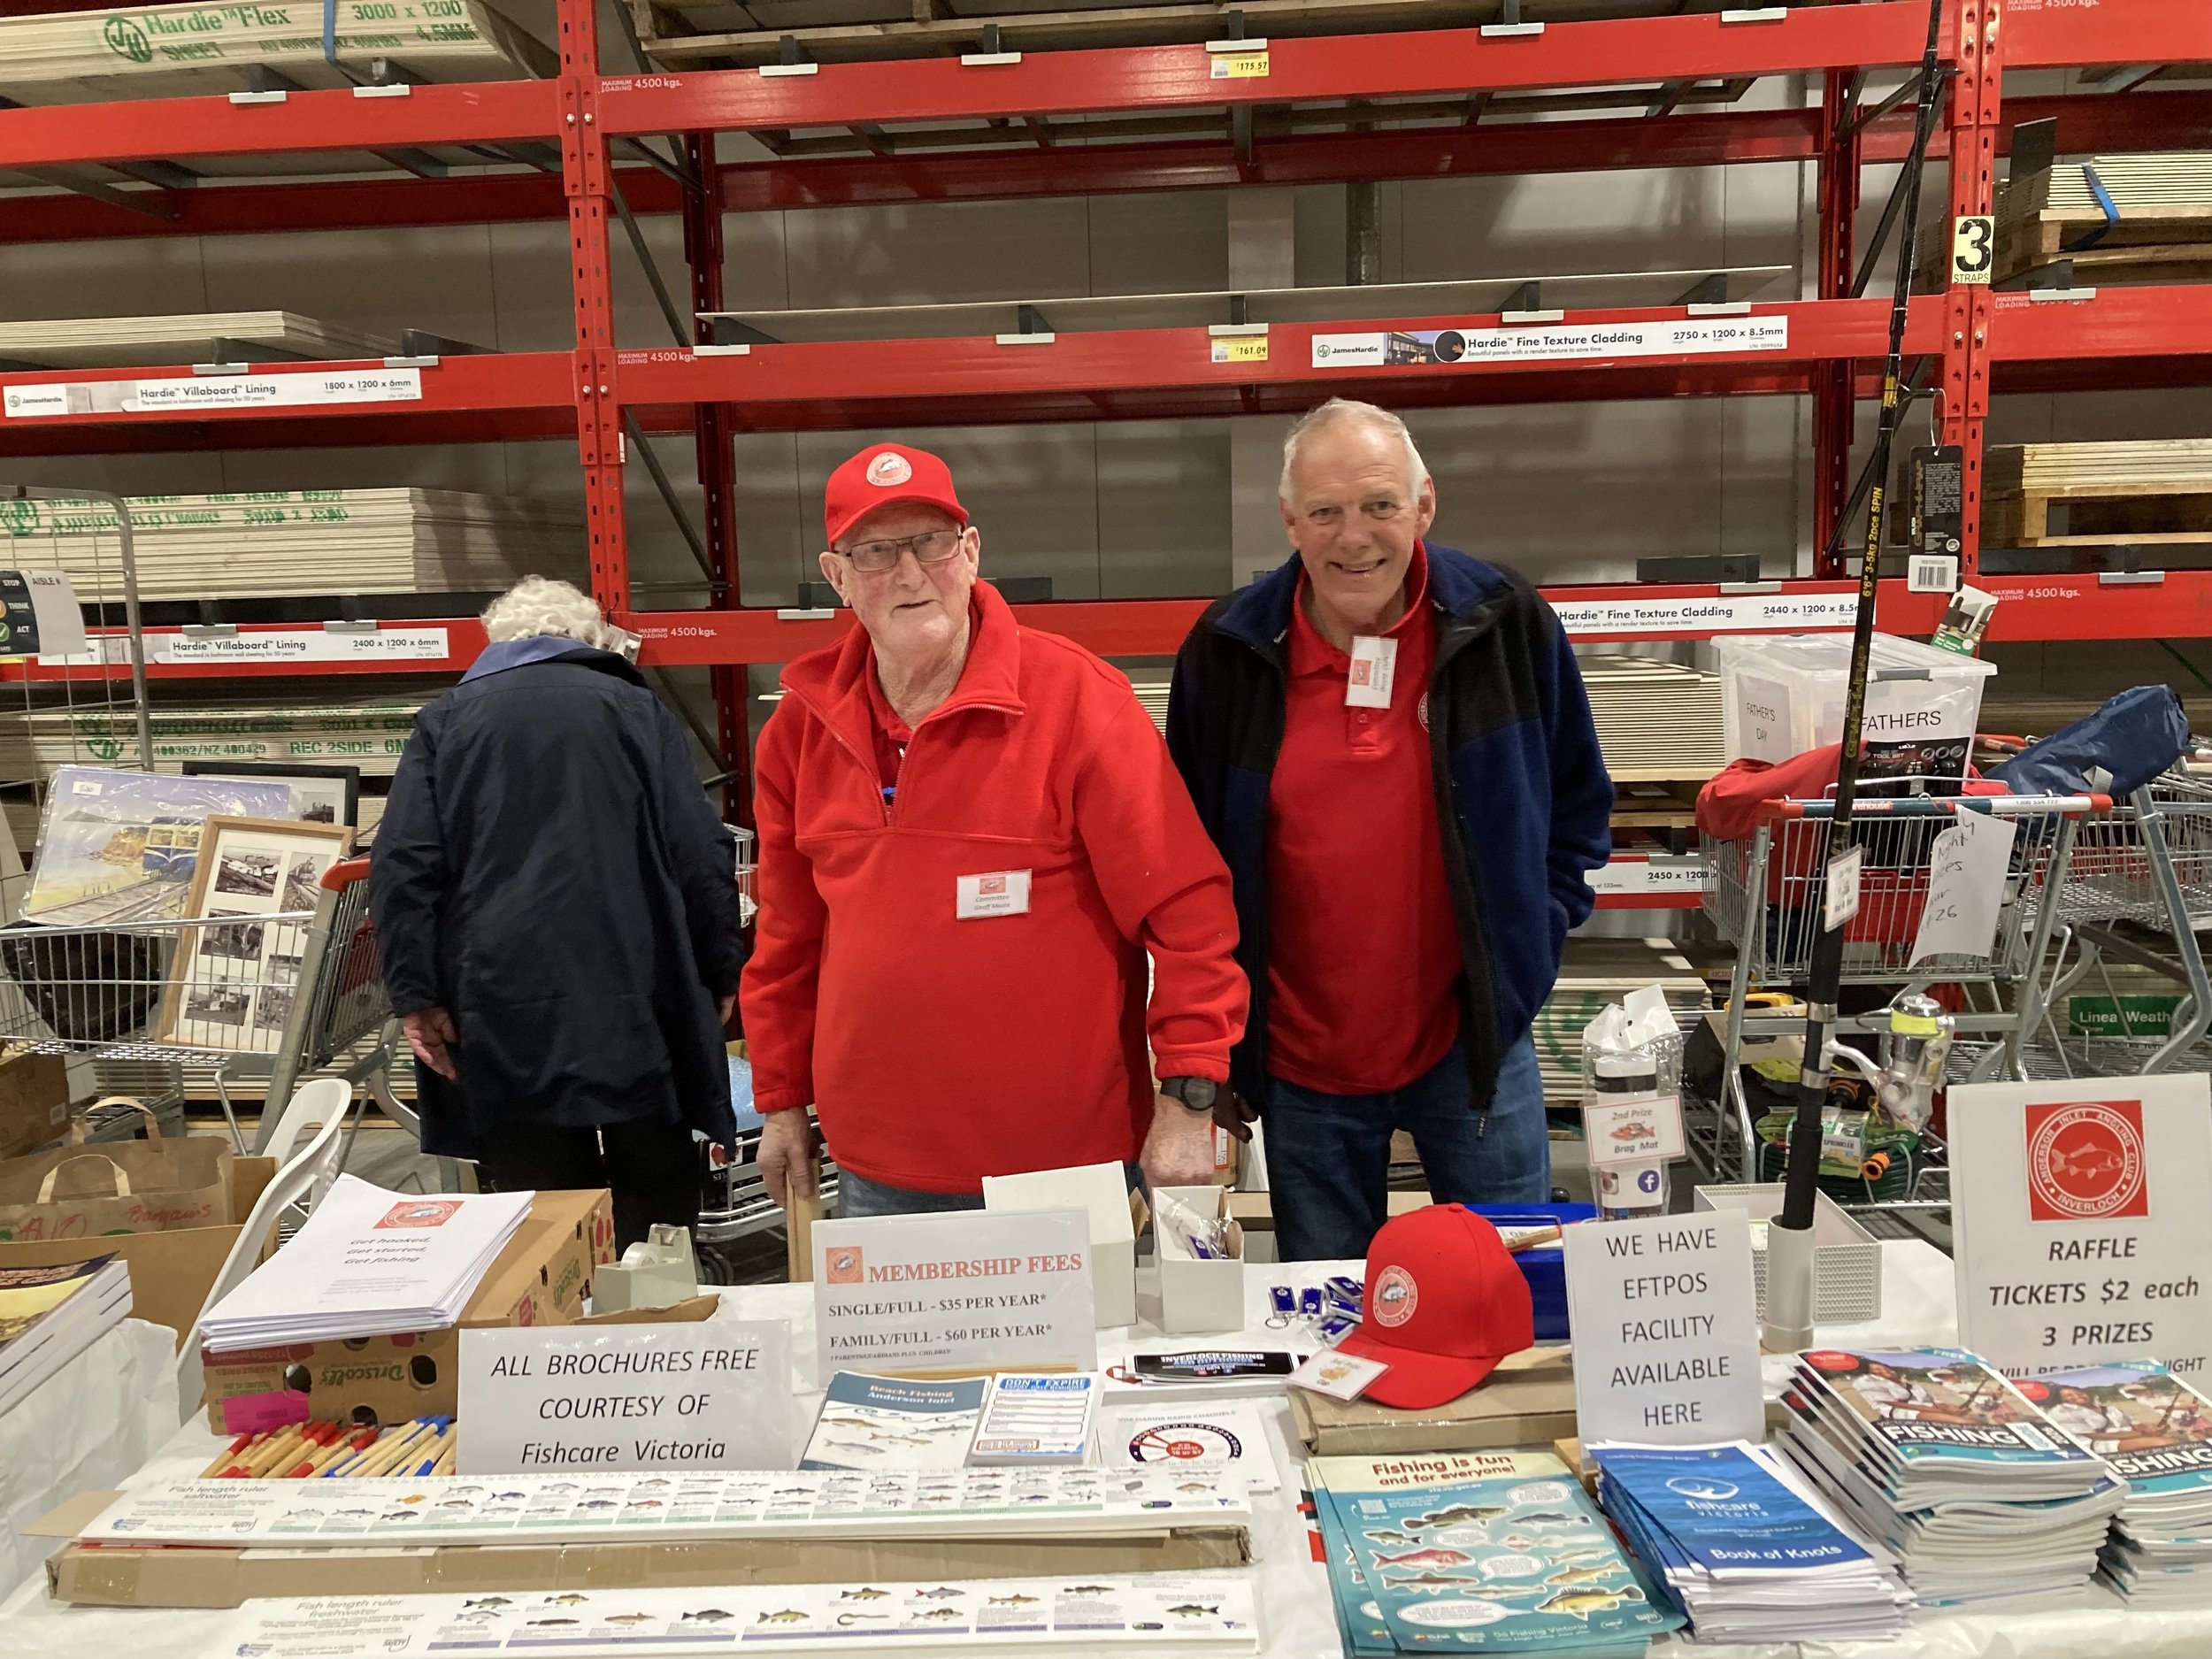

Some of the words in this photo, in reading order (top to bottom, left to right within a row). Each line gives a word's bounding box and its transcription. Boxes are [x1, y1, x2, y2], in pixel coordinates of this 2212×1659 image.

[353, 3, 396, 20] 3000
[421, 0, 462, 17] 1200
[634, 78, 662, 88] 4500
[664, 77, 683, 88] kgs.
[1955, 219, 1992, 272] 3
[1953, 273, 1989, 283] STRAPS
[1517, 337, 1540, 347] Fine
[1543, 335, 1587, 346] Texture
[1591, 334, 1643, 344] Cladding
[1673, 331, 1698, 340] 2750
[1712, 329, 1736, 338] 1200
[1749, 327, 1783, 336] 8.5mm
[650, 351, 677, 362] 4500
[245, 383, 277, 396] Lining
[325, 381, 345, 390] 1800
[357, 380, 378, 388] 1200
[389, 379, 411, 388] 6mm
[1871, 487, 1883, 513] SPIN
[1869, 516, 1879, 541] 2pce
[1865, 544, 1878, 573] 3-5kg
[2026, 588, 2057, 598] 4500
[2059, 588, 2081, 599] kgs.
[1608, 610, 1631, 619] Fine
[1634, 608, 1678, 618] Texture
[1681, 607, 1732, 618] Cladding
[671, 626, 697, 637] 4500
[698, 626, 718, 638] kgs.
[276, 639, 306, 651] Lining
[418, 638, 439, 647] 6mm
[1746, 703, 1776, 722] FATHER'S
[1756, 727, 1768, 741] DAY
[290, 741, 322, 754] REC
[326, 741, 373, 754] 2SIDE
[1686, 871, 1709, 879] 1200
[2079, 1011, 2117, 1023] Linea
[1612, 1110, 1629, 1120] 2nd
[1631, 1108, 1653, 1118] Prize
[1614, 1144, 1636, 1154] Brag
[1640, 1141, 1659, 1150] Mat
[1824, 1139, 1855, 1149] SPRINKLER
[2038, 1128, 2055, 1184] ANDERSON
[2058, 1110, 2087, 1126] INLET
[2096, 1113, 2133, 1147] ANGLING
[2124, 1151, 2136, 1180] CLUB
[2057, 1192, 2121, 1211] INVERLOCH
[1606, 1234, 1645, 1257] WE
[1657, 1228, 1717, 1253] HAVE
[2048, 1237, 2138, 1261] RAFFLE
[371, 1256, 420, 1264] fishing
[869, 1257, 1022, 1283] MEMBERSHIP
[1027, 1253, 1083, 1274] FEES
[1624, 1272, 1708, 1300] EFTPOS
[1990, 1282, 2086, 1306] TICKETS
[2101, 1278, 2130, 1305] $2
[2144, 1276, 2200, 1300] each
[828, 1302, 928, 1317] SINGLE/FULL
[940, 1298, 963, 1312] $35
[966, 1296, 995, 1310] PER
[1622, 1314, 1715, 1343] FACILITY
[2042, 1326, 2056, 1348] 3
[2071, 1322, 2154, 1346] PRIZES
[829, 1331, 933, 1348] FAMILY/FULL
[945, 1329, 967, 1343] $60
[972, 1327, 1001, 1340] PER
[918, 1348, 951, 1357] CHILDREN
[1161, 1353, 1219, 1363] INVERLOCH
[1219, 1352, 1265, 1361] FISHING
[1933, 1348, 1968, 1360] FREE
[490, 1356, 533, 1377] ALL
[547, 1351, 694, 1375] BROCHURES
[701, 1348, 759, 1371] FREE
[2122, 1363, 2154, 1371] FREE
[321, 1363, 404, 1387] Driscoll's
[1611, 1356, 1731, 1387] AVAILABLE
[1005, 1379, 1043, 1388] DON'T
[1046, 1377, 1087, 1387] EXPIRE
[867, 1392, 925, 1403] Anderson
[870, 1385, 906, 1395] Beach
[910, 1388, 954, 1398] Fishing
[539, 1395, 665, 1419] COURTESY
[678, 1394, 710, 1416] OF
[1644, 1402, 1702, 1427] HERE
[1882, 1425, 2020, 1444] FISHING
[521, 1441, 619, 1464] Fishcare
[634, 1438, 726, 1461] Victoria
[1372, 1460, 1448, 1477] Fishing
[1453, 1457, 1469, 1468] is
[1473, 1455, 1512, 1466] fun
[1379, 1475, 1409, 1486] and
[1412, 1473, 1435, 1484] for
[1440, 1464, 1516, 1480] everyone!
[1686, 1500, 1761, 1511] fishcare
[1697, 1509, 1770, 1517] victoria
[1710, 1549, 1760, 1561] Book
[1764, 1548, 1781, 1560] of
[1786, 1545, 1843, 1558] Knots
[296, 1601, 323, 1610] Fish
[326, 1600, 369, 1609] length
[309, 1609, 380, 1617] freshwater
[1509, 1627, 1547, 1638] Fishing
[1548, 1622, 1589, 1634] Victoria
